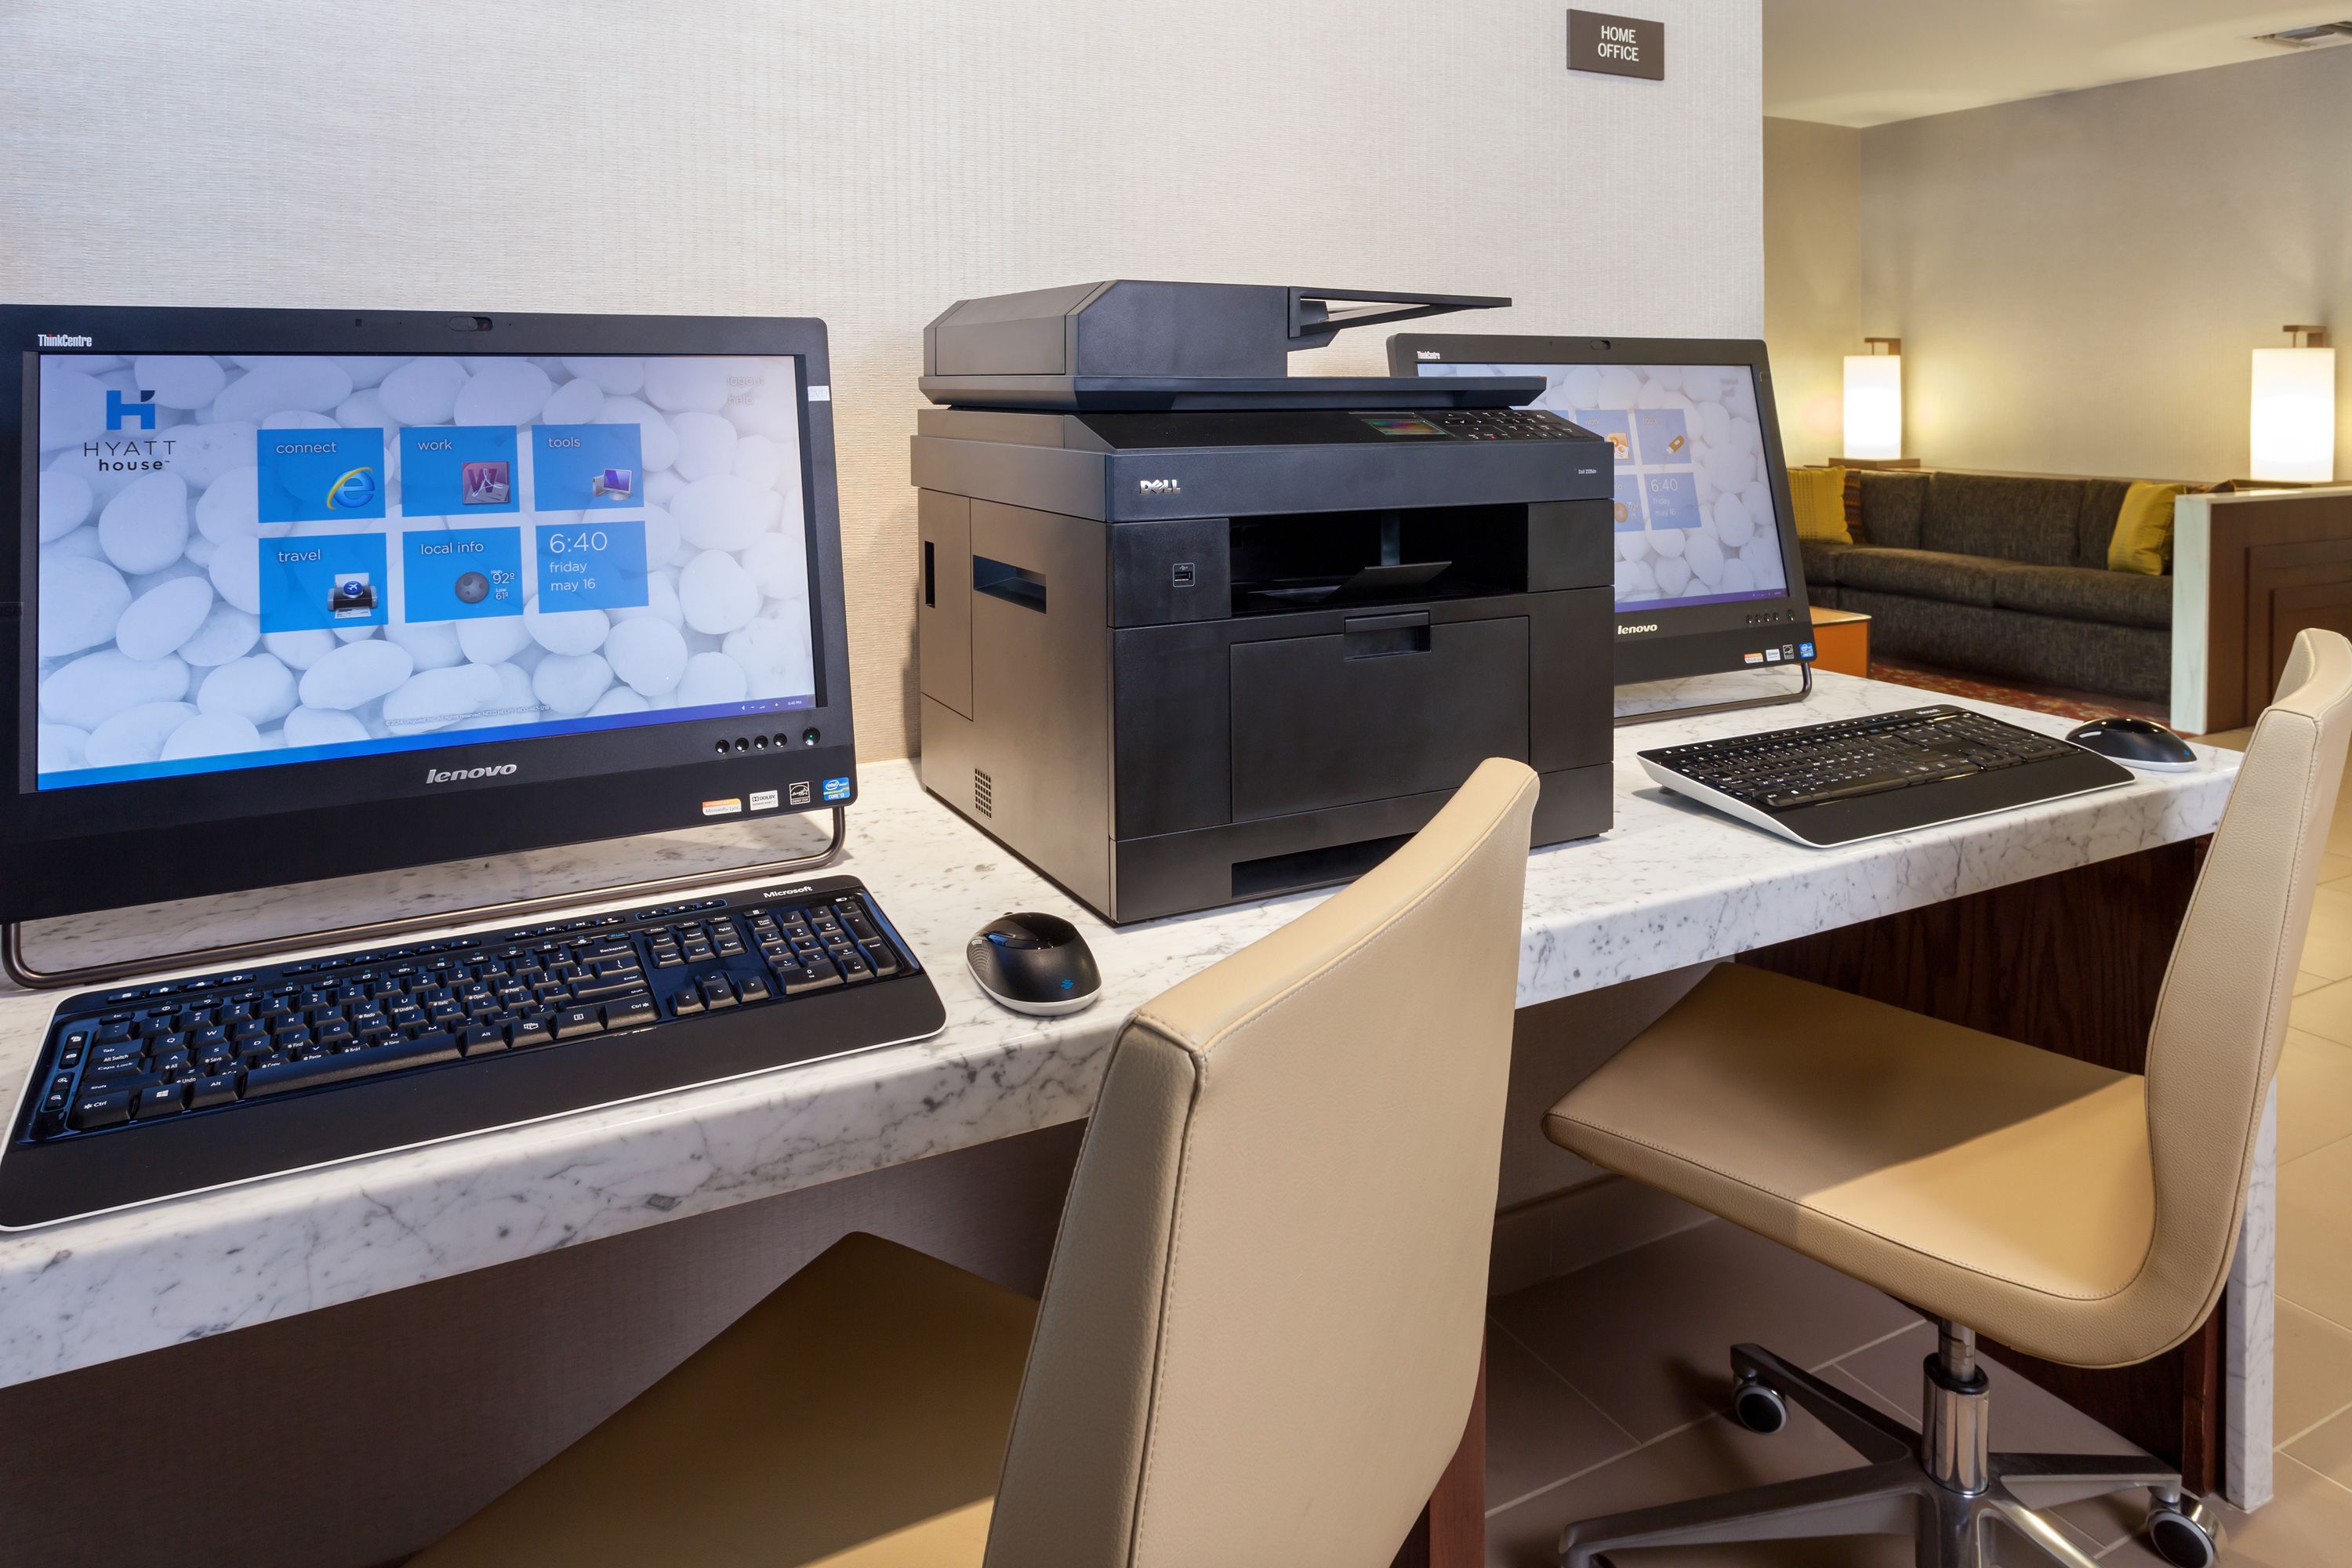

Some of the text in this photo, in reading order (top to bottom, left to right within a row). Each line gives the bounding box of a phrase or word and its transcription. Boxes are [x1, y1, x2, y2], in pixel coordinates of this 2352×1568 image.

[1601, 25, 1636, 44] HOME
[1597, 42, 1639, 61] OFFICE
[38, 334, 93, 347] ThinkCentre
[728, 376, 764, 387] logout
[728, 394, 753, 405] help
[84, 441, 176, 456] HYATT
[276, 441, 337, 454] connect
[417, 439, 452, 451] work
[548, 437, 581, 448] tools
[99, 459, 163, 471] house
[1140, 479, 1181, 495] DELL
[1650, 478, 1679, 492] 6:40
[421, 542, 484, 555] local info
[550, 532, 608, 554] 6:40
[278, 549, 321, 562] travel
[550, 561, 587, 573] friday
[551, 579, 596, 592] may 16
[1617, 624, 1658, 635] lenovo
[426, 764, 517, 784] lenovo
[764, 886, 812, 898] Microsoft
[600, 945, 627, 953] Backspace
